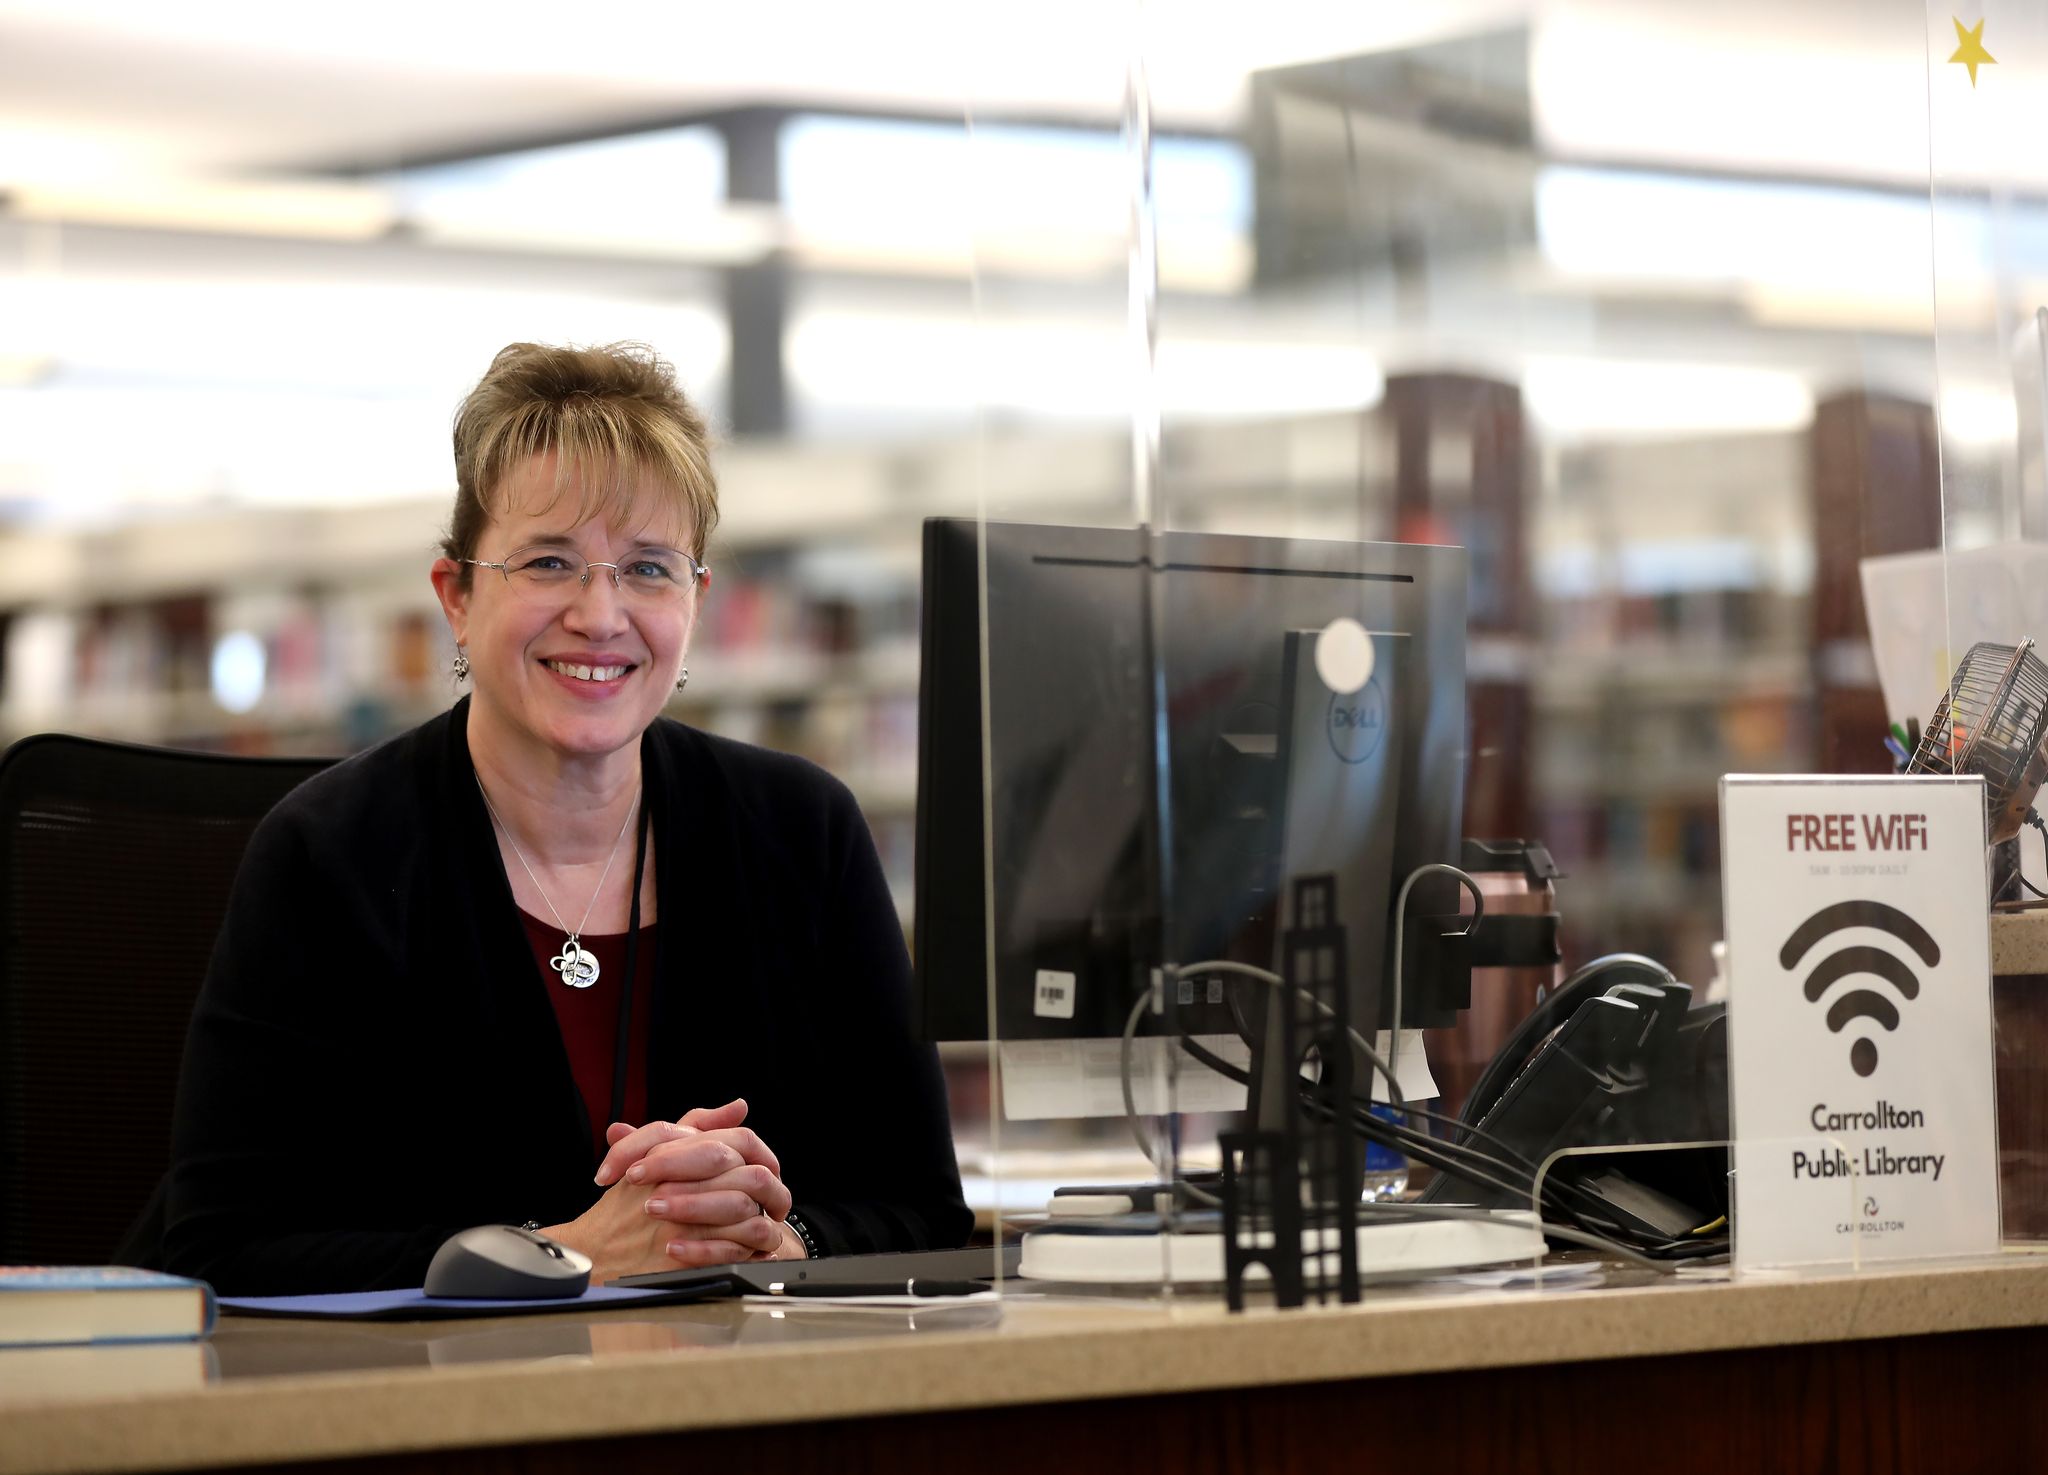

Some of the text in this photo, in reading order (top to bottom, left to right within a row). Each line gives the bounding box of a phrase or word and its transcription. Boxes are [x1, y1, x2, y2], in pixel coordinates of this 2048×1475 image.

[1333, 706, 1378, 729] DELL
[1787, 814, 1927, 851] FREE WiFi
[1811, 1100, 1925, 1132] Carrollton
[1864, 1146, 1945, 1182] Library
